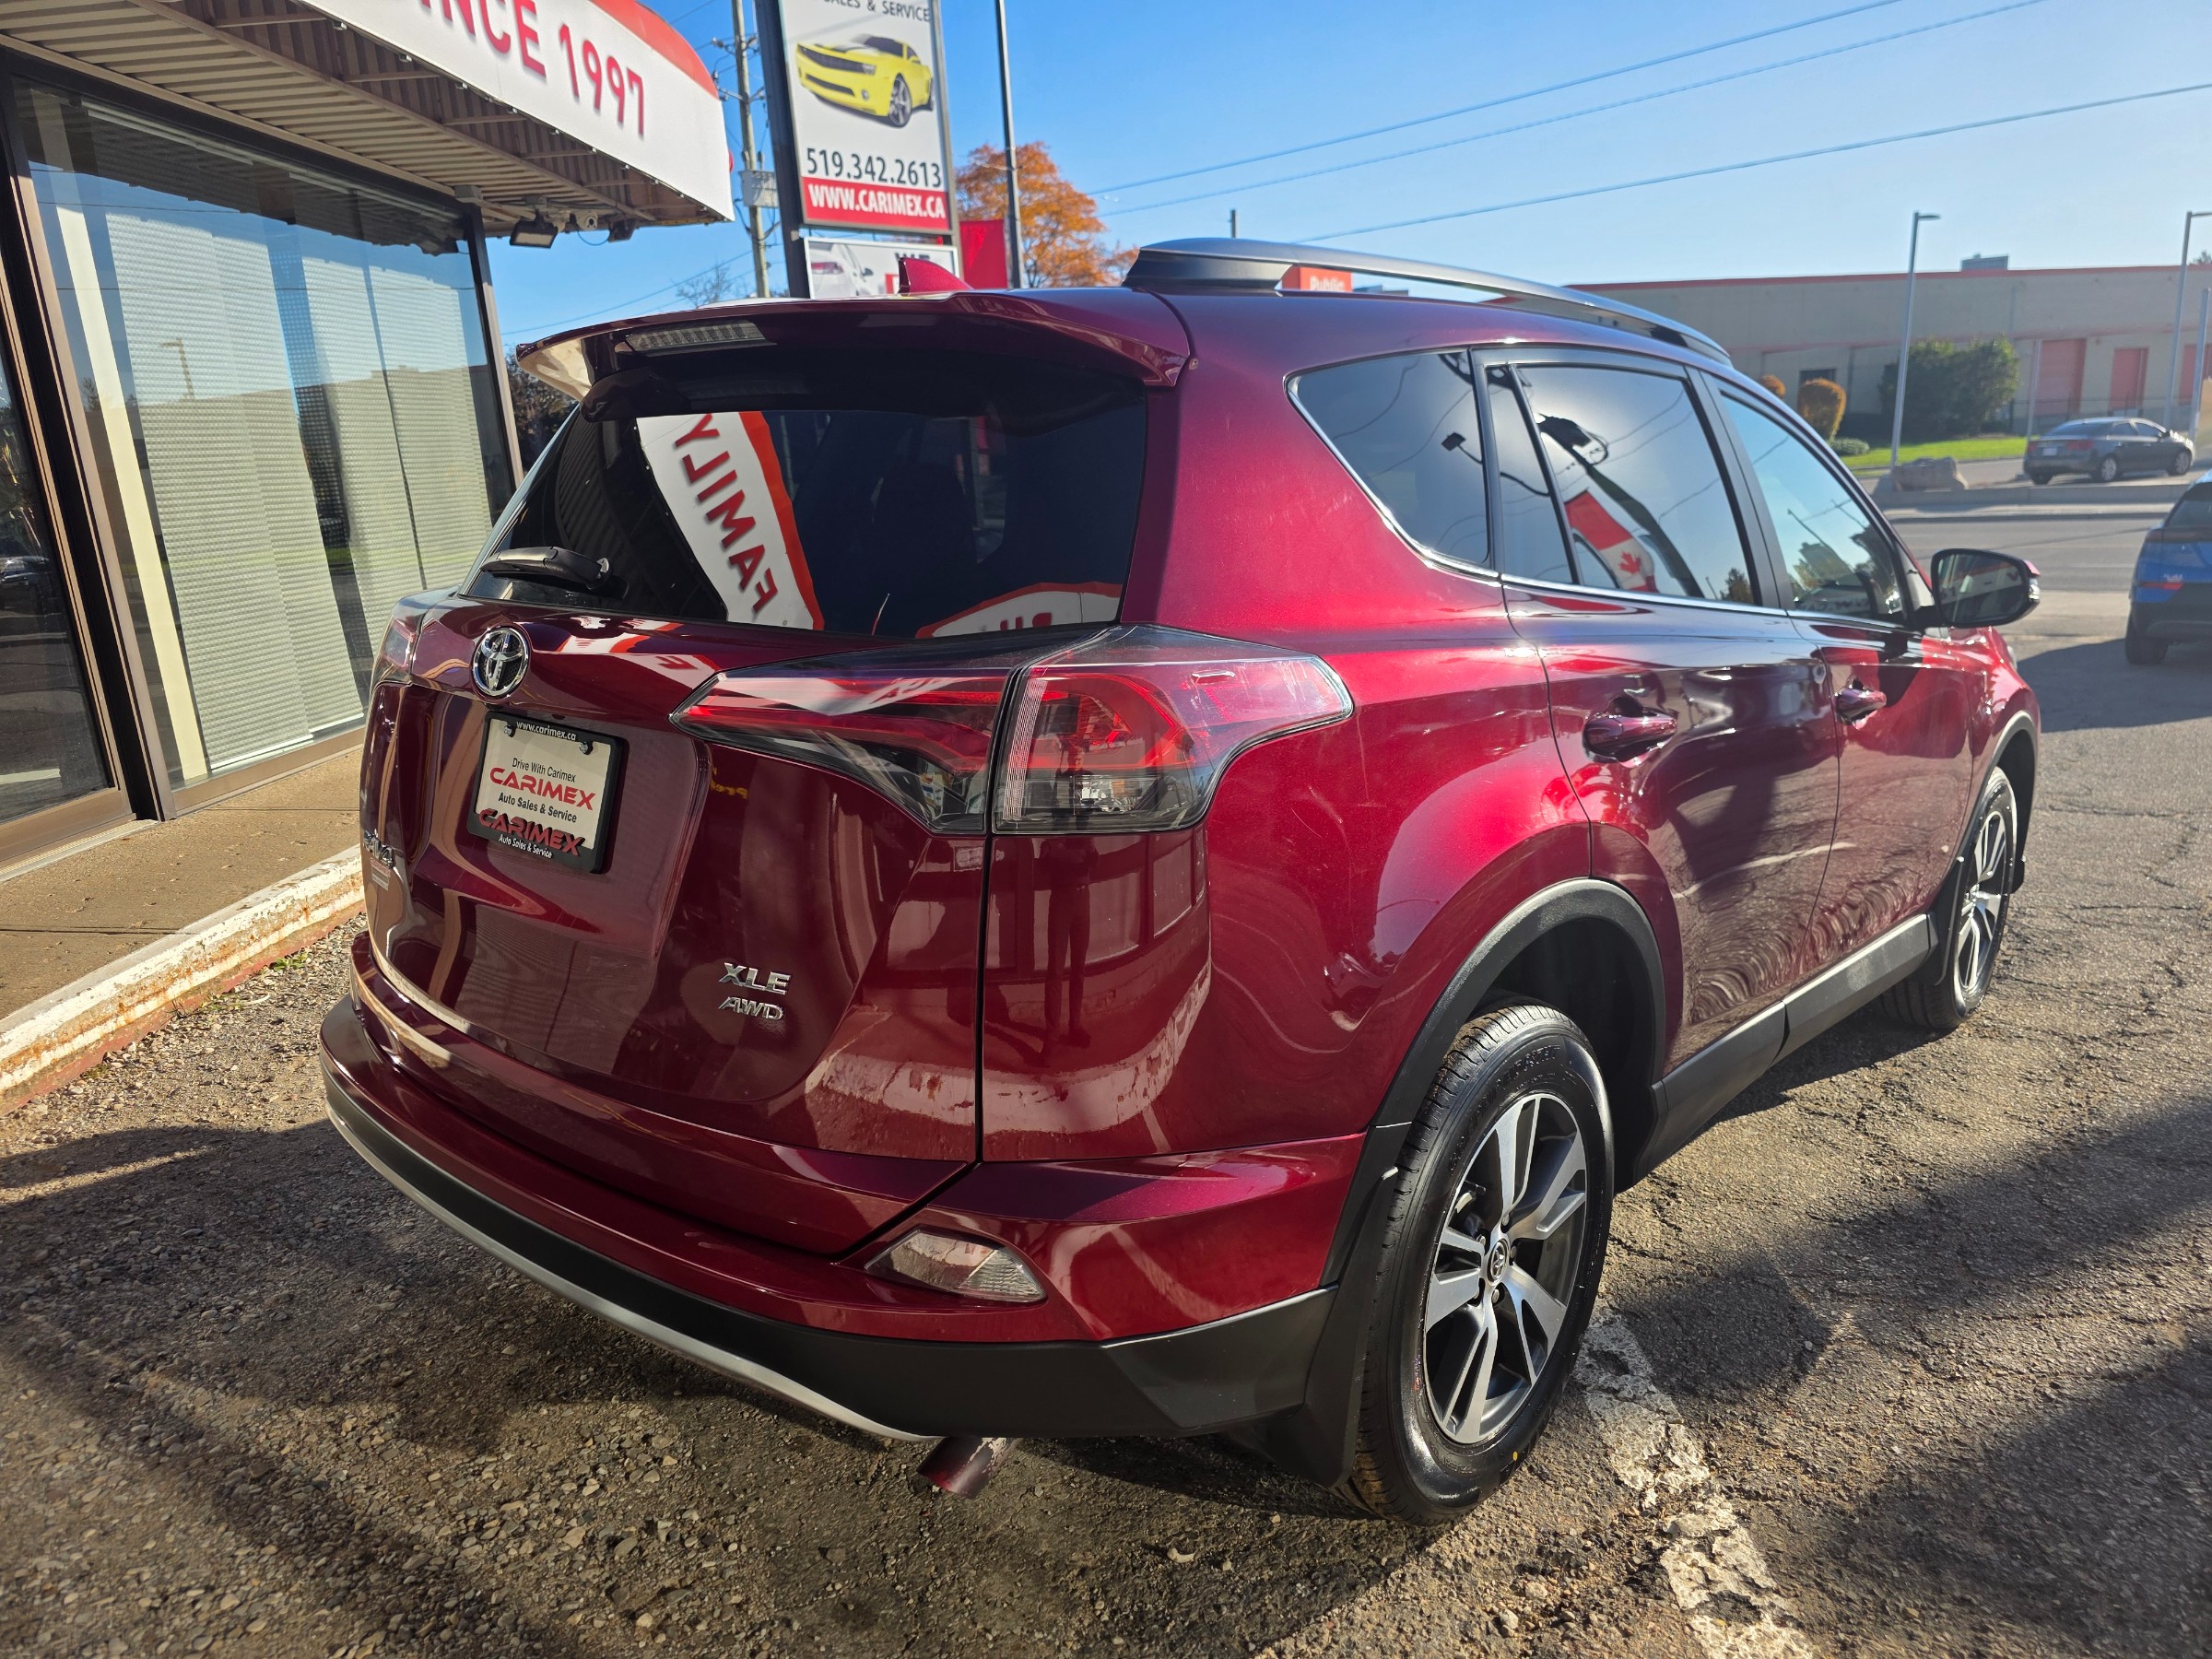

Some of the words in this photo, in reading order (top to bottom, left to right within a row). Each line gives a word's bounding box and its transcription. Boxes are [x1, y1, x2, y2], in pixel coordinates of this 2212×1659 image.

[824, 0, 860, 8] LES
[867, 0, 876, 12] &
[882, 0, 931, 22] SERVICE
[559, 23, 644, 135] 1997
[806, 147, 941, 188] 519.342.2613
[808, 183, 947, 218] WWW.CARIMEX.CA
[516, 721, 577, 741] www.carimex.ca
[512, 757, 530, 771] Drive
[531, 762, 546, 775] With
[547, 766, 577, 782] Carimex
[489, 767, 596, 811] CARIMEX
[499, 792, 516, 806] Auto
[517, 797, 538, 812] Sales
[539, 804, 547, 814] &
[547, 806, 577, 823] Service
[478, 808, 585, 856] CARIMEX
[499, 834, 512, 845] Auto
[512, 838, 526, 852] Sales
[526, 843, 532, 853] &
[532, 845, 553, 859] Service
[718, 962, 792, 995] XLE
[718, 996, 783, 1020] AWD
